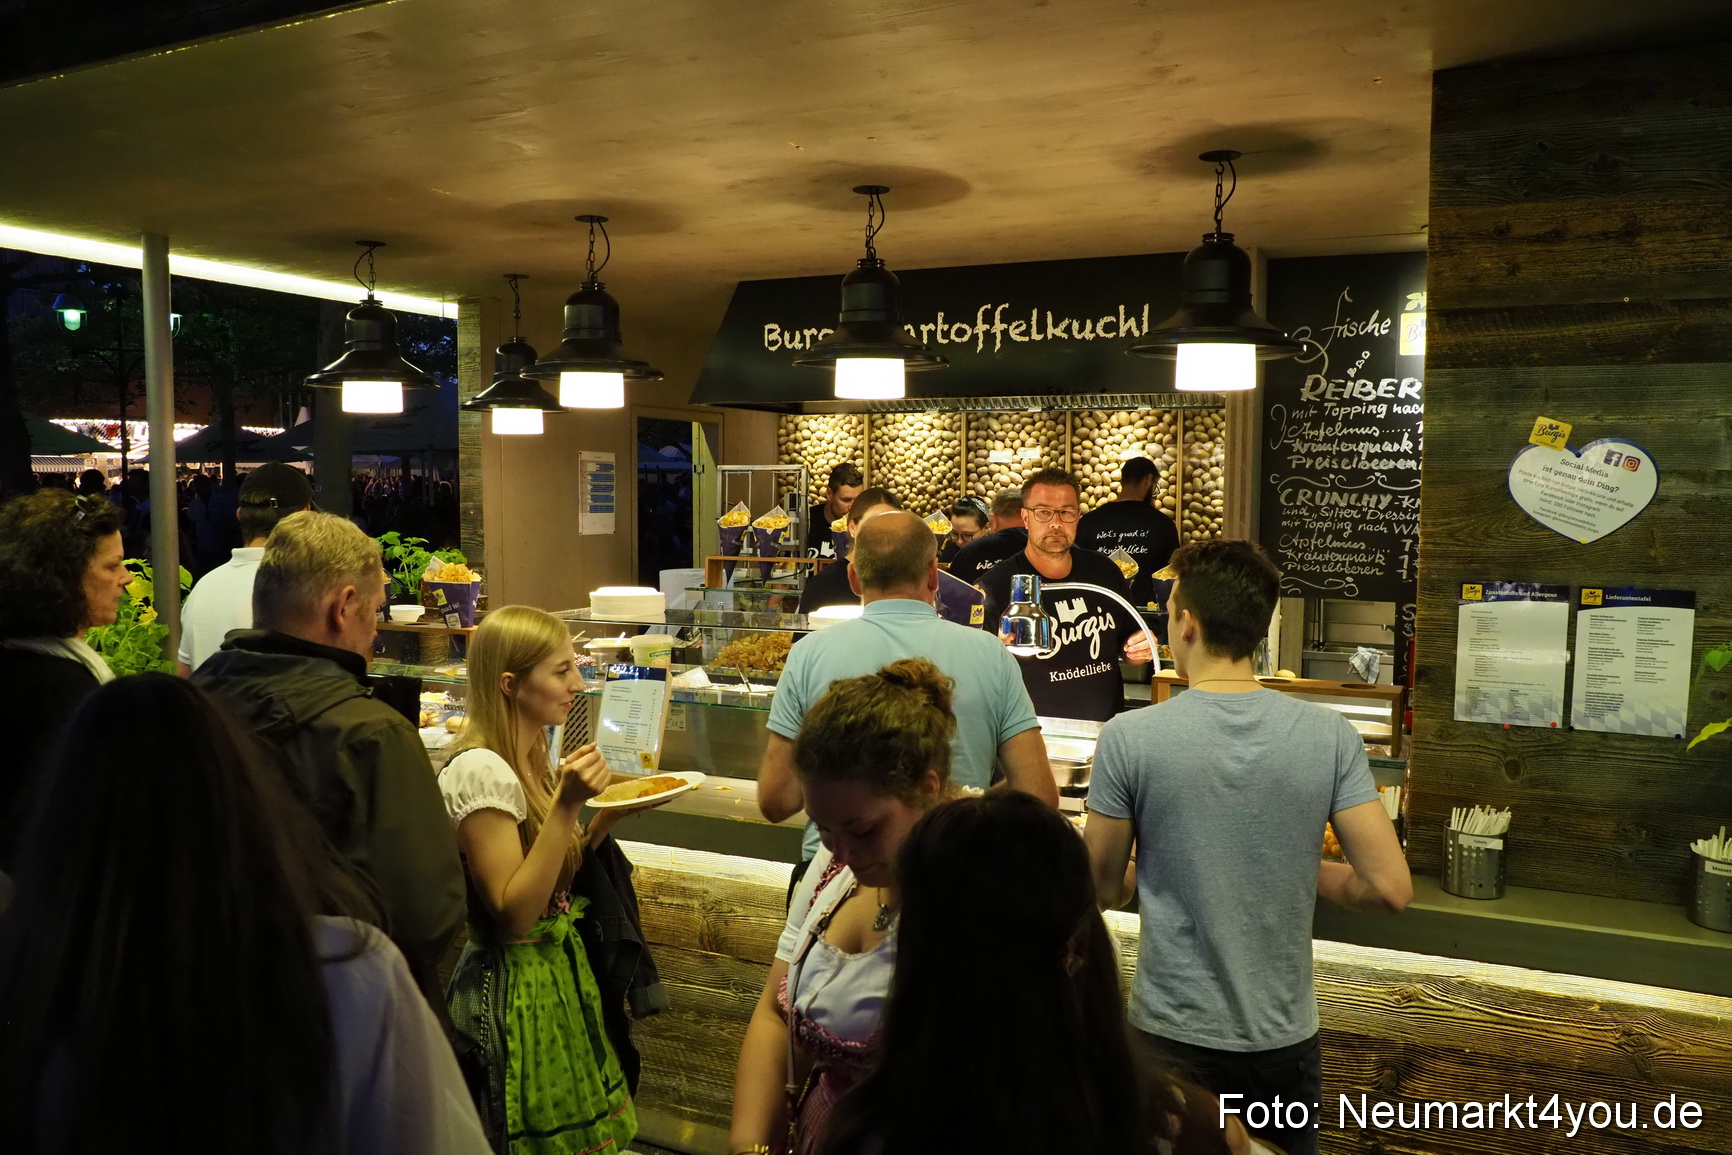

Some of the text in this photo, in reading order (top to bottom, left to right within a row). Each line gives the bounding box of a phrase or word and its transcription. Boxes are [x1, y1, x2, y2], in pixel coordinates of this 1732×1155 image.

[1320, 286, 1391, 350] frische
[904, 303, 1150, 354] rtoffelkuchl
[1292, 404, 1318, 420] mit
[1324, 402, 1388, 421] Topping
[1535, 424, 1566, 444] Burgis
[1560, 458, 1609, 478] Social Media
[1542, 465, 1553, 474] ist
[1553, 469, 1577, 481] genau
[1578, 476, 1595, 486] dein
[1596, 480, 1620, 493] Ding?
[1540, 490, 1564, 502] Facebook
[1576, 499, 1601, 513] Instagram
[1606, 494, 1617, 503] und
[1282, 506, 1310, 516] und
[1366, 508, 1421, 521] Dressin
[1563, 504, 1584, 515] Follower
[1281, 516, 1420, 538] mit Topping nach WA
[1282, 561, 1385, 576] Preiselbeeren
[1605, 594, 1652, 602] Lieferantentafel
[1036, 606, 1116, 660] Burgis
[1049, 661, 1113, 683] Knödelliebe
